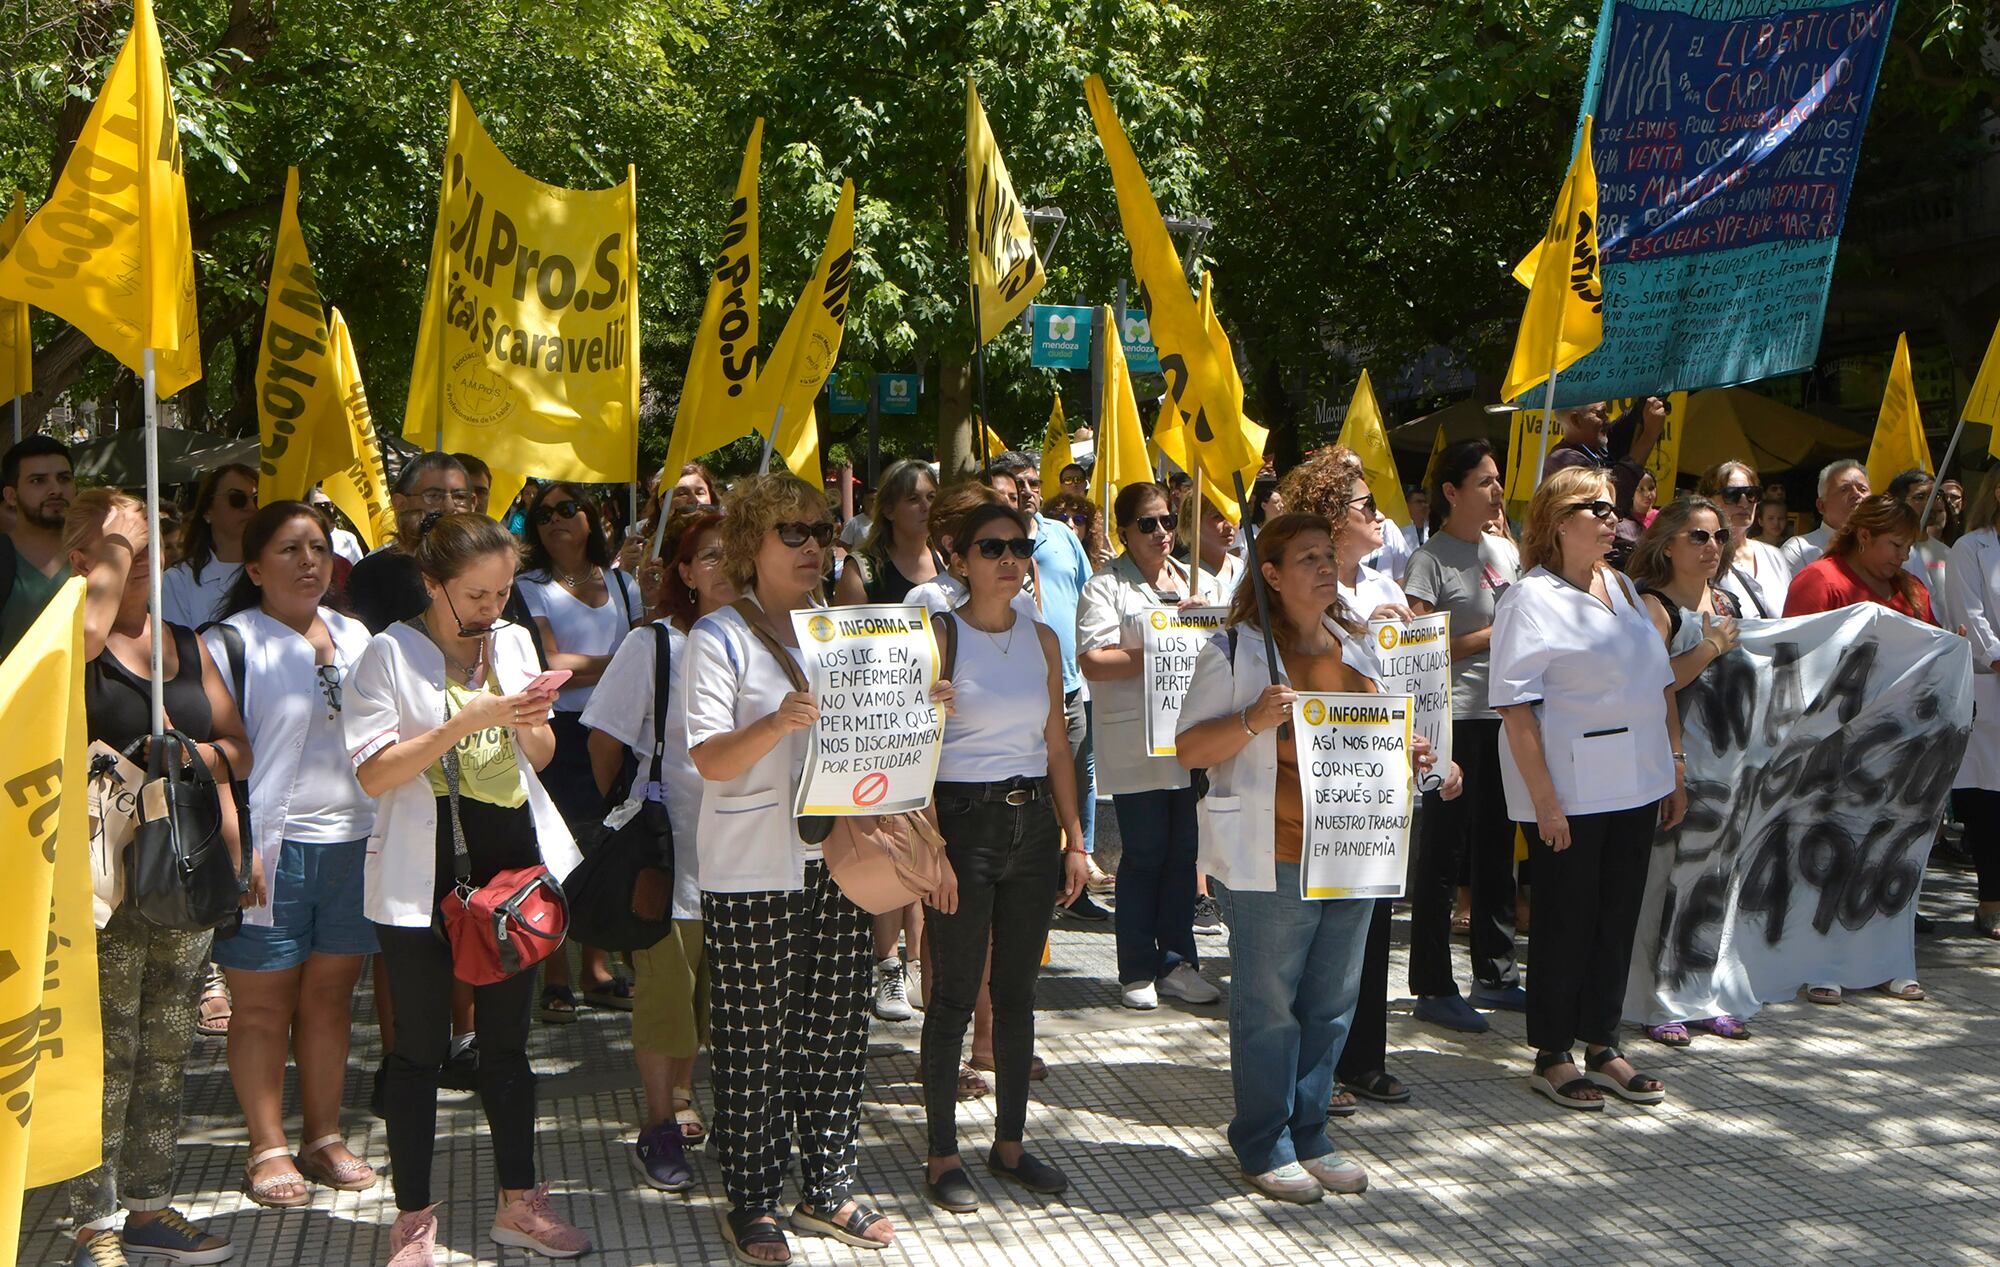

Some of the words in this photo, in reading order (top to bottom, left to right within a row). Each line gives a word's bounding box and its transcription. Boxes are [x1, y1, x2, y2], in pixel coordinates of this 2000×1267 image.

[1625, 145, 1684, 172] VENTA
[482, 303, 625, 373] Scaravelli
[1042, 341, 1079, 350] mendoza
[839, 618, 909, 637] INFORMA
[1170, 615, 1218, 628] INFORMA
[1157, 637, 1187, 653] LOS
[1400, 626, 1438, 645] INFORMA
[818, 649, 848, 668] LOS
[853, 647, 882, 667] LIC.
[889, 646, 908, 664] EN
[1155, 656, 1171, 673] EN
[1174, 655, 1197, 672] ENF
[1382, 648, 1449, 678] LICENCIADOS
[830, 658, 923, 688] ENFERMERÍA
[1405, 678, 1421, 693] EN
[821, 694, 850, 711] NO
[852, 690, 905, 707] VAMOS
[914, 690, 925, 705] A
[1161, 696, 1179, 711] AL
[820, 712, 901, 732] PERMITIR
[905, 707, 938, 730] QUE
[1329, 706, 1389, 723] INFORMA
[820, 737, 849, 754] NOS
[855, 727, 942, 754] DISCRIMINEN
[1342, 735, 1369, 751] NOS
[1372, 736, 1404, 751] PAGA
[821, 759, 849, 774] POR
[853, 749, 922, 773] ESTUDIAR
[1312, 761, 1384, 778] CORNEJO
[1315, 782, 1372, 804] DESPUÉS
[1378, 789, 1395, 804] DE
[1314, 815, 1366, 831] NUESTRO
[1369, 814, 1410, 830] TRABAJO
[1314, 843, 1329, 857] EN
[1737, 818, 1933, 946] 4966
